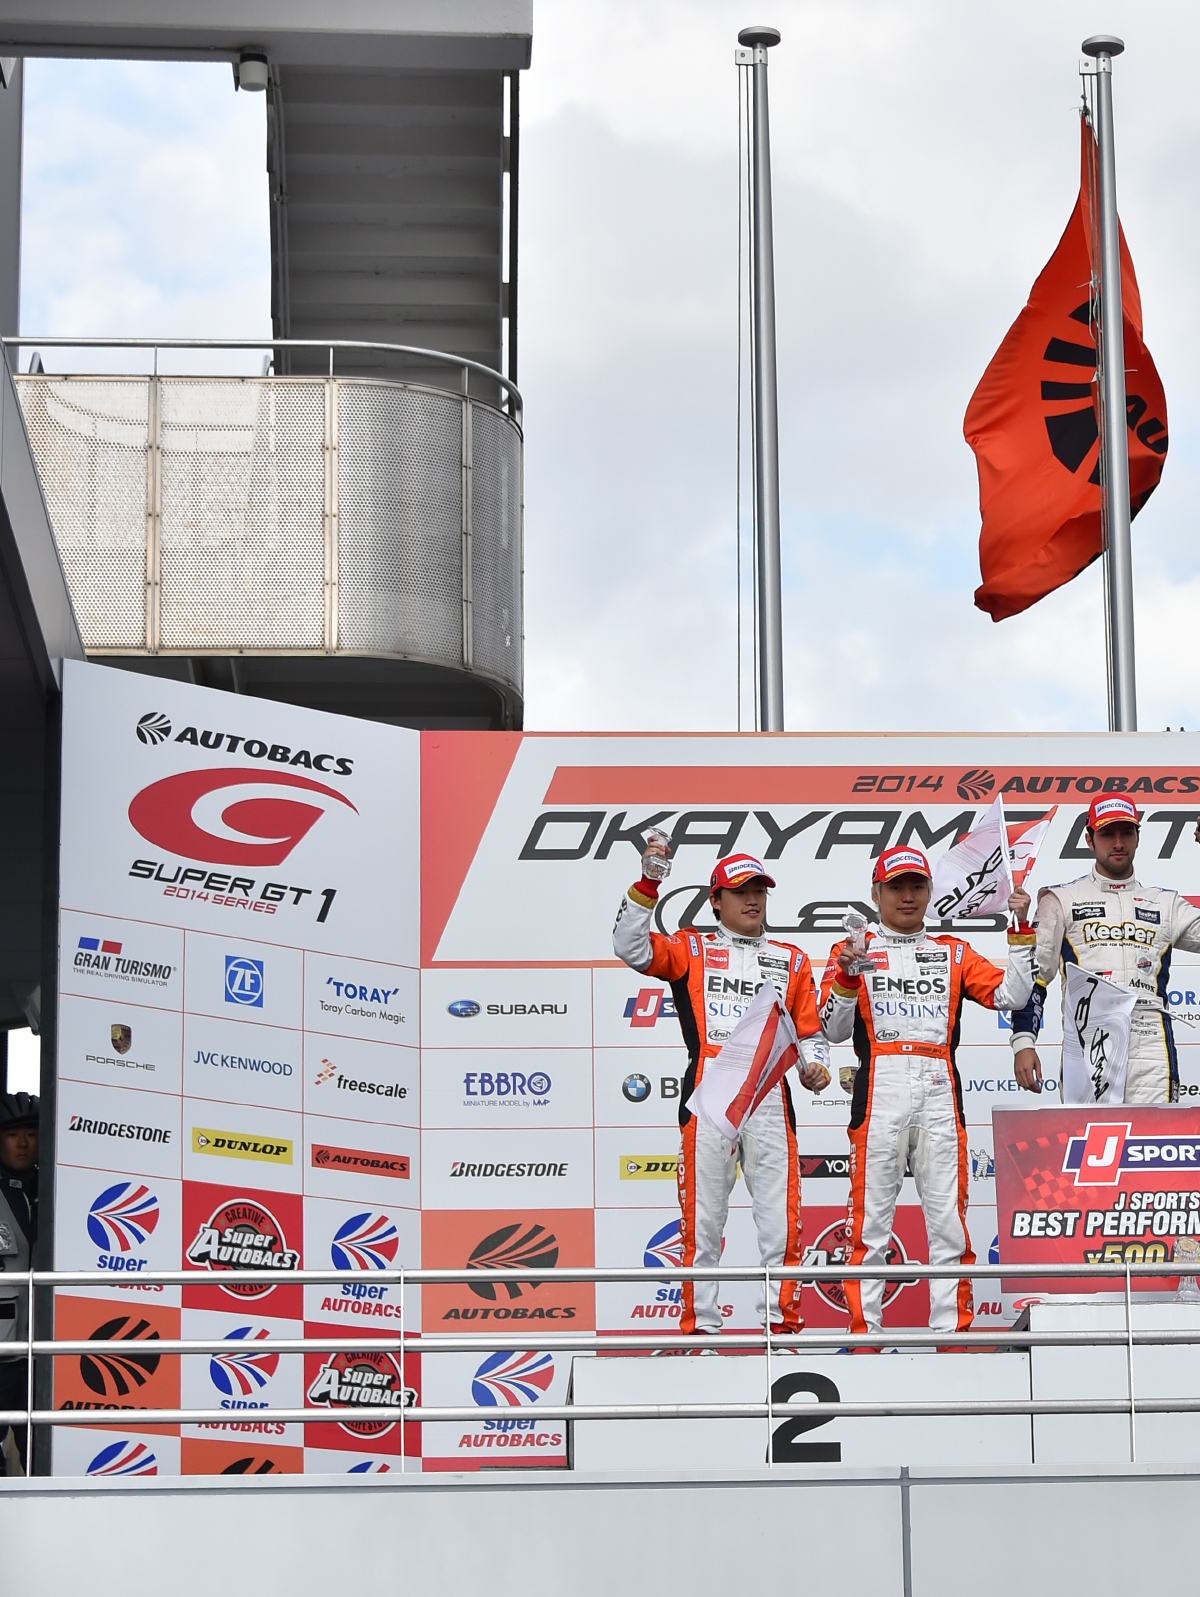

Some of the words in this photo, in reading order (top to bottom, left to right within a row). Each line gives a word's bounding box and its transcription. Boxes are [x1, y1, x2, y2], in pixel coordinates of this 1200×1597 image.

[174, 726, 354, 776] AUTOBACS
[851, 776, 943, 793] 2014
[999, 776, 1200, 793] AUTOBACS
[128, 859, 256, 897] SUPER
[260, 882, 312, 906] GT
[316, 888, 337, 923] 1
[163, 885, 210, 902] 2014
[211, 892, 279, 916] SERIES
[1083, 922, 1156, 945] KeePer
[74, 952, 111, 970] GRAN
[115, 957, 172, 980] TURISMO
[73, 967, 85, 975] THE
[86, 969, 103, 977] REAL
[104, 972, 130, 981] DRIVING
[131, 976, 168, 987] SIMULATOR
[873, 977, 946, 994] ENEOS
[1128, 979, 1156, 993] Advox
[331, 979, 394, 1004] TORAY
[707, 993, 742, 1002] PREMIUM
[320, 1000, 343, 1016] Toray
[344, 1004, 377, 1019] Carbon
[378, 1010, 406, 1025] Magic
[487, 1004, 568, 1015] SUBARU
[875, 1002, 946, 1018] SUSTINA
[877, 1029, 898, 1038] Arai
[86, 1055, 155, 1071] PORSCHE
[337, 1074, 407, 1099] freescale
[463, 1072, 551, 1096] EBBRO
[523, 1100, 530, 1108] by
[68, 1115, 172, 1144] BRIDGESTONE
[211, 1136, 288, 1157] DUNLOP
[1087, 1136, 1119, 1168] J
[331, 1154, 408, 1172] AUTOBACS
[449, 1162, 569, 1178] BRIDGESTONE
[1114, 1192, 1127, 1211] J
[225, 1207, 266, 1227] CREATIVE
[1012, 1212, 1080, 1237] BEST
[189, 1226, 294, 1269] AUTOBACS
[221, 1228, 273, 1248] Super
[321, 1297, 404, 1319] AUTOBACS
[442, 1307, 576, 1320] AUTOBACS
[342, 1368, 393, 1387] Super
[766, 1371, 842, 1464] 2
[458, 1433, 562, 1448] AUTOBACS
